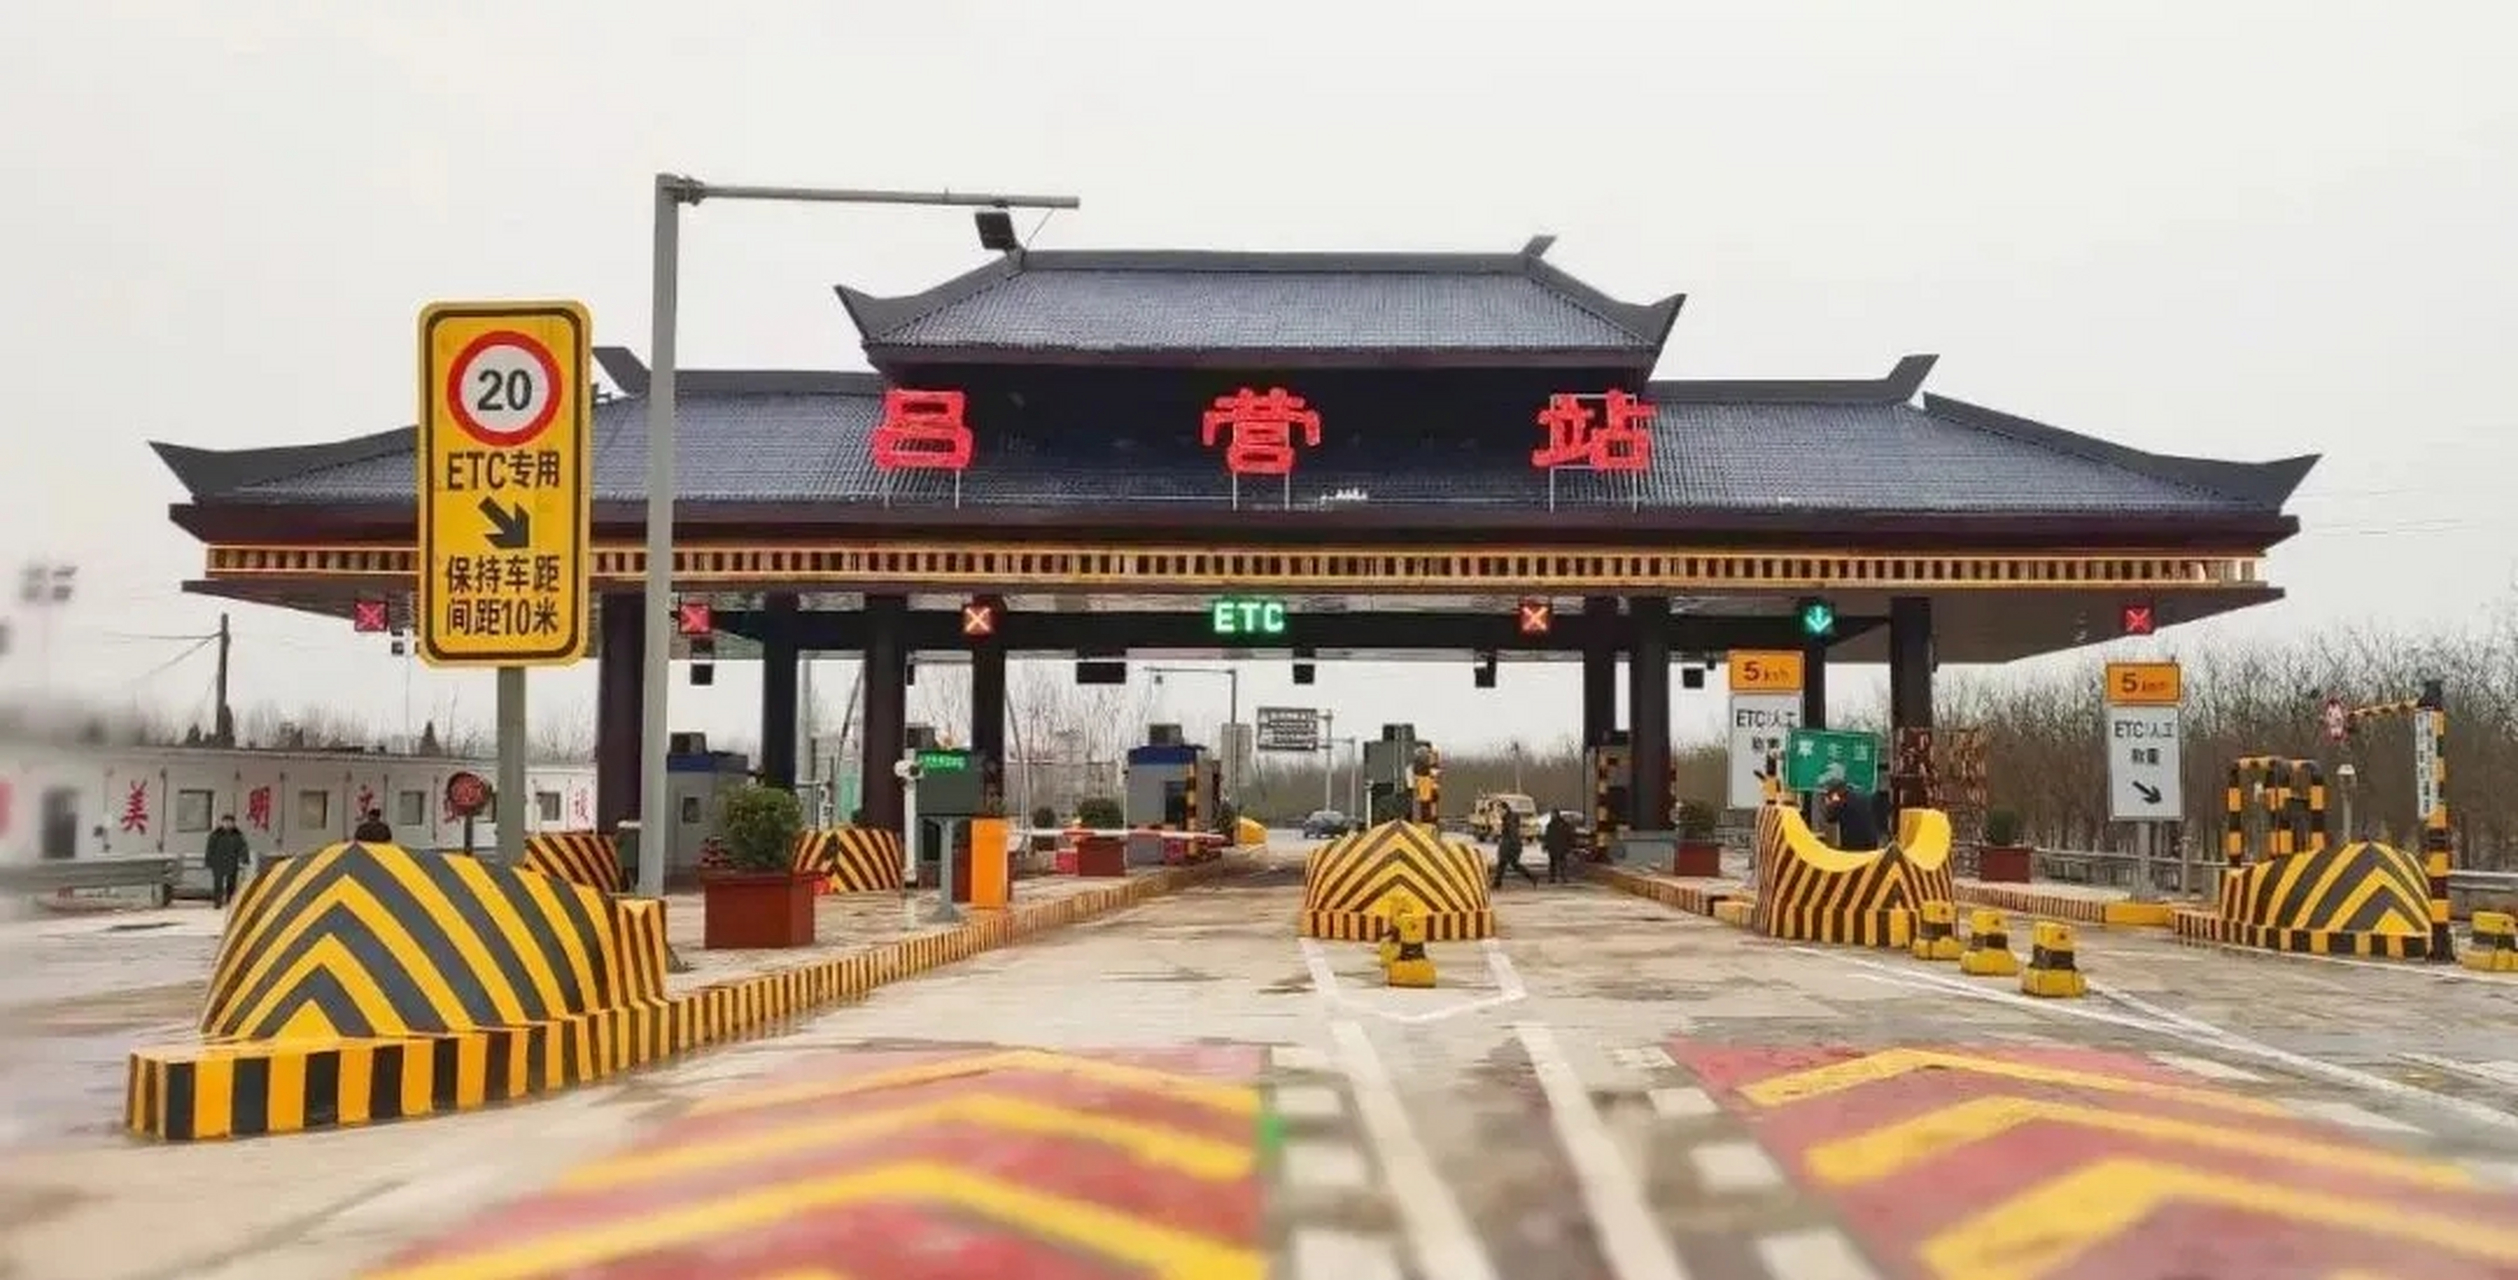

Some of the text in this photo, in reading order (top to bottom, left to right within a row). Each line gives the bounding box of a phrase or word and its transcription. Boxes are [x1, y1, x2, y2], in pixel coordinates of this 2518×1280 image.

[476, 368, 532, 411] 20
[872, 387, 1654, 474] 吕营站
[447, 450, 560, 491] ETC专用
[446, 554, 560, 594] 保持车距
[446, 597, 559, 637] 间距10米
[1213, 601, 1285, 633] ETC
